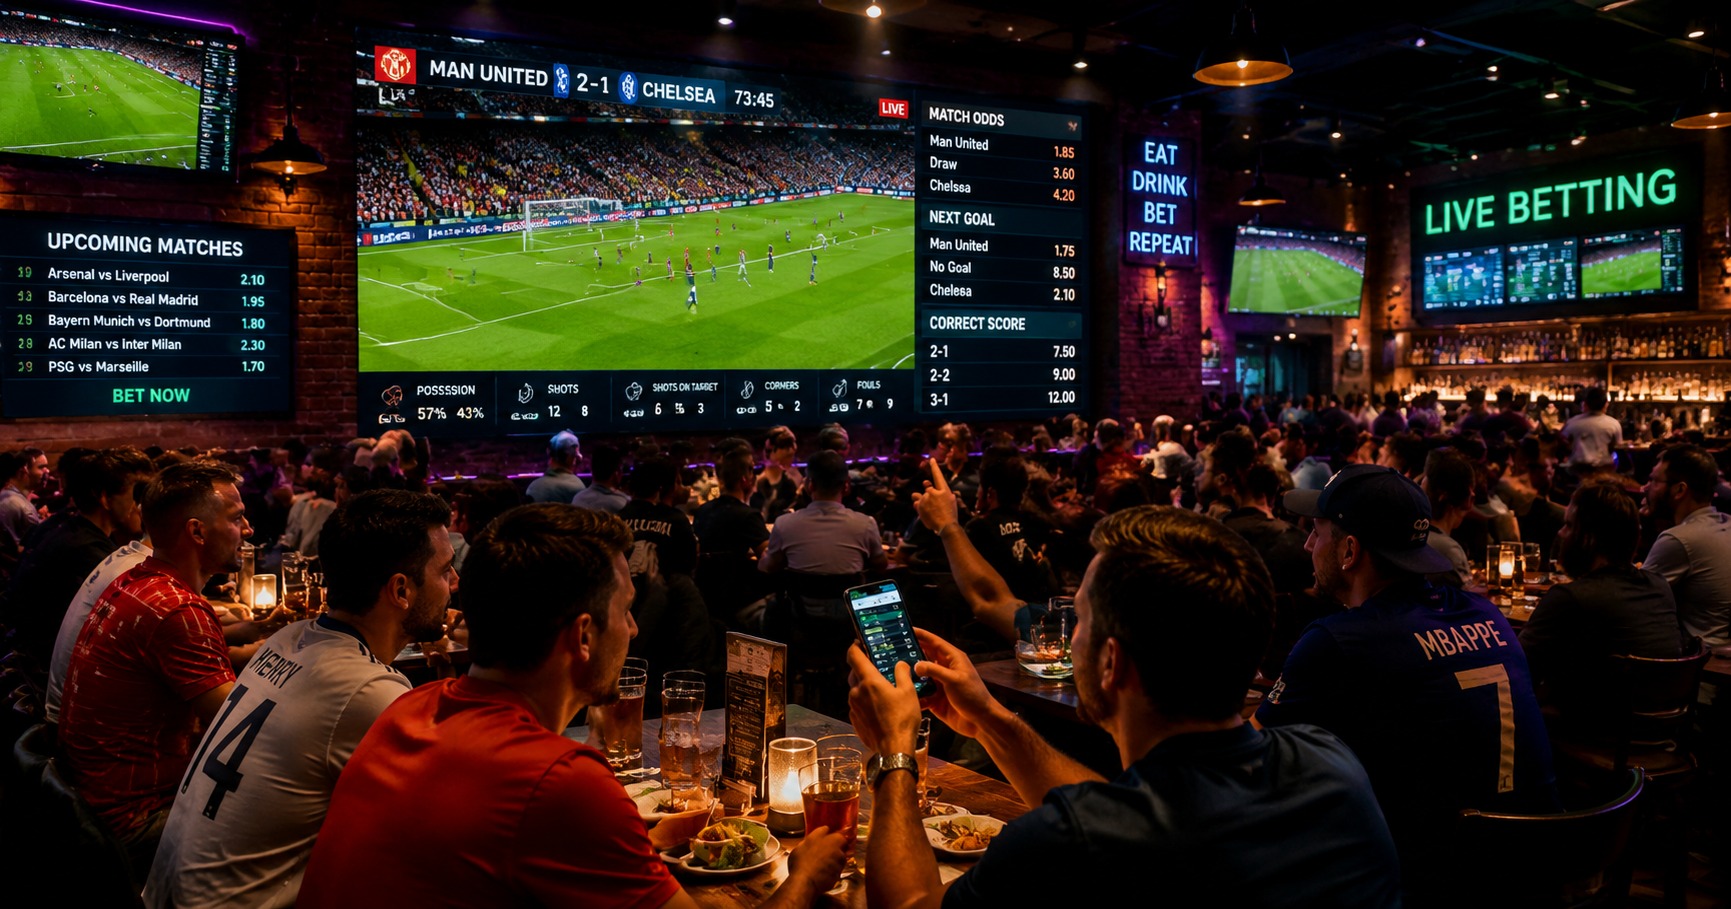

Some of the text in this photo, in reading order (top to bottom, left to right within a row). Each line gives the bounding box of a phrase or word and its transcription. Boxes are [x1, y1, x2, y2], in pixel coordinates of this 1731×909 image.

[430, 59, 774, 109] MAN UNITED 2-1 CHELSEA 73:45
[882, 102, 905, 116] LIVE
[929, 107, 1004, 127] MATCH ODDS
[930, 135, 1075, 159] Man United 1.85
[1145, 141, 1178, 165] EAT
[930, 156, 1075, 180] Draw 3.60
[1133, 170, 1188, 197] DRINK
[1053, 188, 1075, 202] 4.20
[1425, 168, 1677, 235] LIVE BETTING
[929, 210, 995, 226] NEXT GOAL
[1144, 201, 1177, 225] BET
[47, 232, 243, 257] UPCOMING MATCHES
[930, 237, 1075, 257] Man United 1.75
[1129, 231, 1193, 255] REPEAT
[48, 267, 95, 280] Arsenal
[98, 271, 112, 281] vs
[115, 270, 169, 284] Liverpool
[241, 274, 265, 286] 2.10
[930, 260, 1075, 279] No Goal 8.50
[48, 290, 109, 304] Barcelona
[112, 295, 126, 304] vs
[130, 293, 155, 305] Real
[158, 294, 199, 306] Madrid
[242, 296, 265, 307] 1.95
[1053, 288, 1075, 301] 2.10
[48, 314, 90, 328] Bayern
[94, 315, 135, 327] Munich
[138, 317, 151, 327] vs
[154, 316, 211, 328] Dortmund
[242, 318, 265, 329] 1.80
[929, 316, 1026, 331] CORRECT SCORE
[48, 338, 66, 349] AC
[70, 338, 102, 349] Milan
[105, 340, 119, 349] vs
[122, 338, 149, 350] Inter
[152, 339, 182, 350] Milan
[241, 340, 265, 351] 2.30
[930, 345, 1075, 358] 2-1 7.50
[48, 361, 74, 372] PSG
[78, 364, 92, 372] vs
[96, 360, 149, 372] Marseille
[242, 361, 265, 372] 1.70
[930, 368, 1075, 382] 2-2 9.00
[652, 382, 678, 392] SHOTS
[857, 380, 881, 390] FOULS
[112, 388, 190, 403] BET NOW
[930, 391, 1075, 406] 3-1 12.00
[548, 405, 561, 417] 12
[582, 405, 588, 417] 8
[655, 402, 662, 415] 6
[698, 402, 704, 414] 3
[765, 400, 773, 412] 5
[794, 400, 801, 412] 2
[856, 398, 863, 410] 7
[887, 398, 894, 409] 9
[417, 407, 447, 420] 57%
[457, 406, 485, 419] 43%
[1413, 620, 1508, 661] MBAPPE
[1454, 663, 1515, 793] 7
[181, 683, 277, 821] 14
